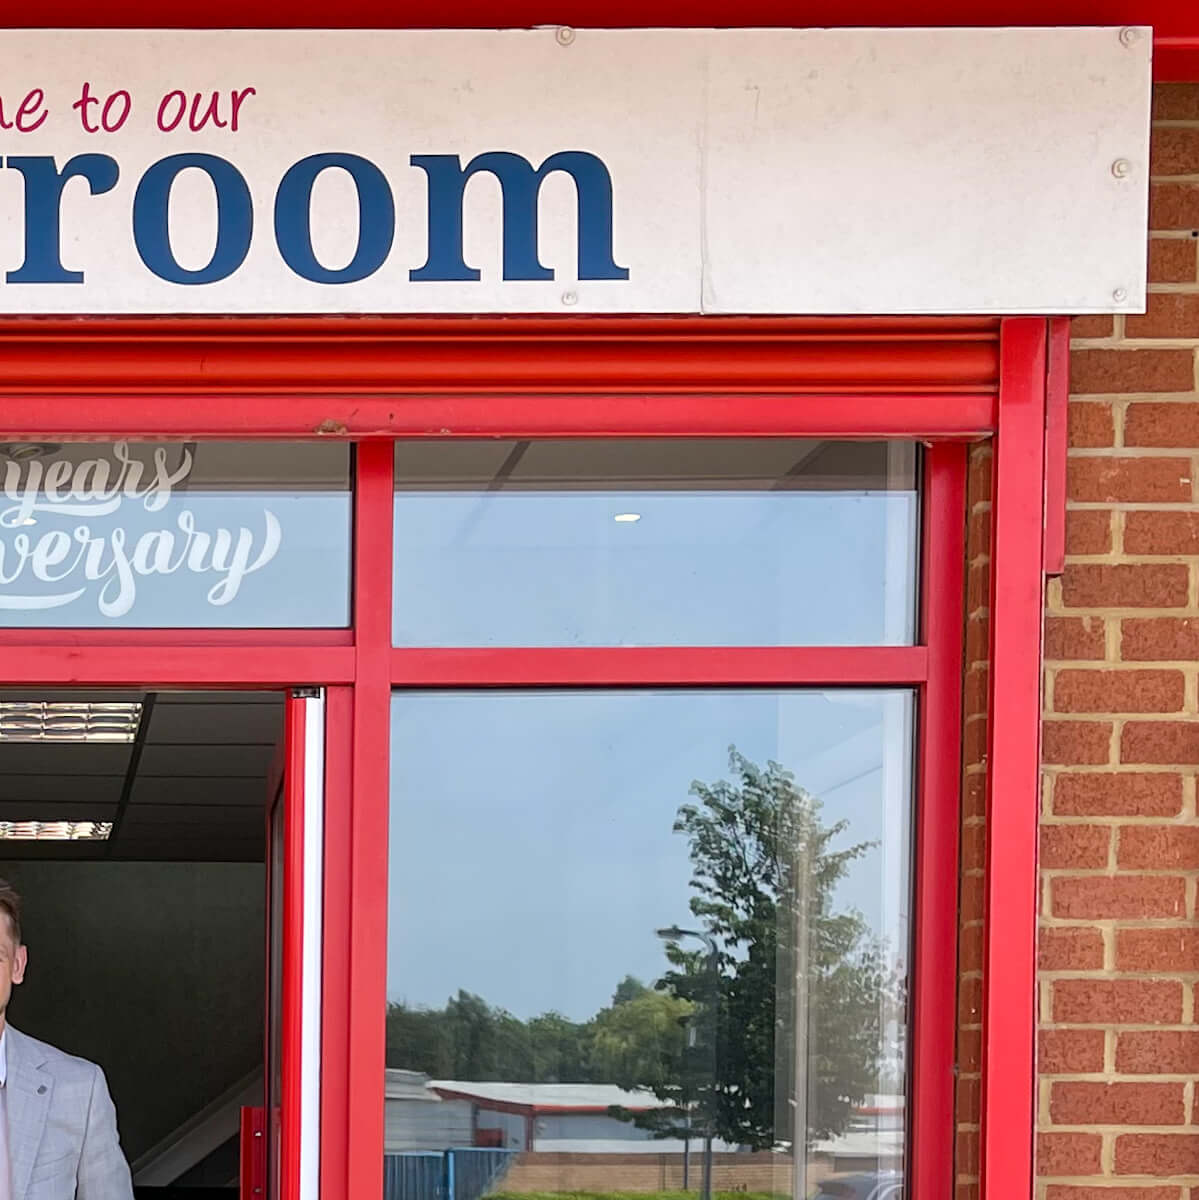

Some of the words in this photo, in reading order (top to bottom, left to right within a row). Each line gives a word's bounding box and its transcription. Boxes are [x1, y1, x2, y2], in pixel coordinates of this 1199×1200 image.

[72, 82, 131, 133] to
[156, 87, 257, 133] our
[0, 440, 193, 528] years
